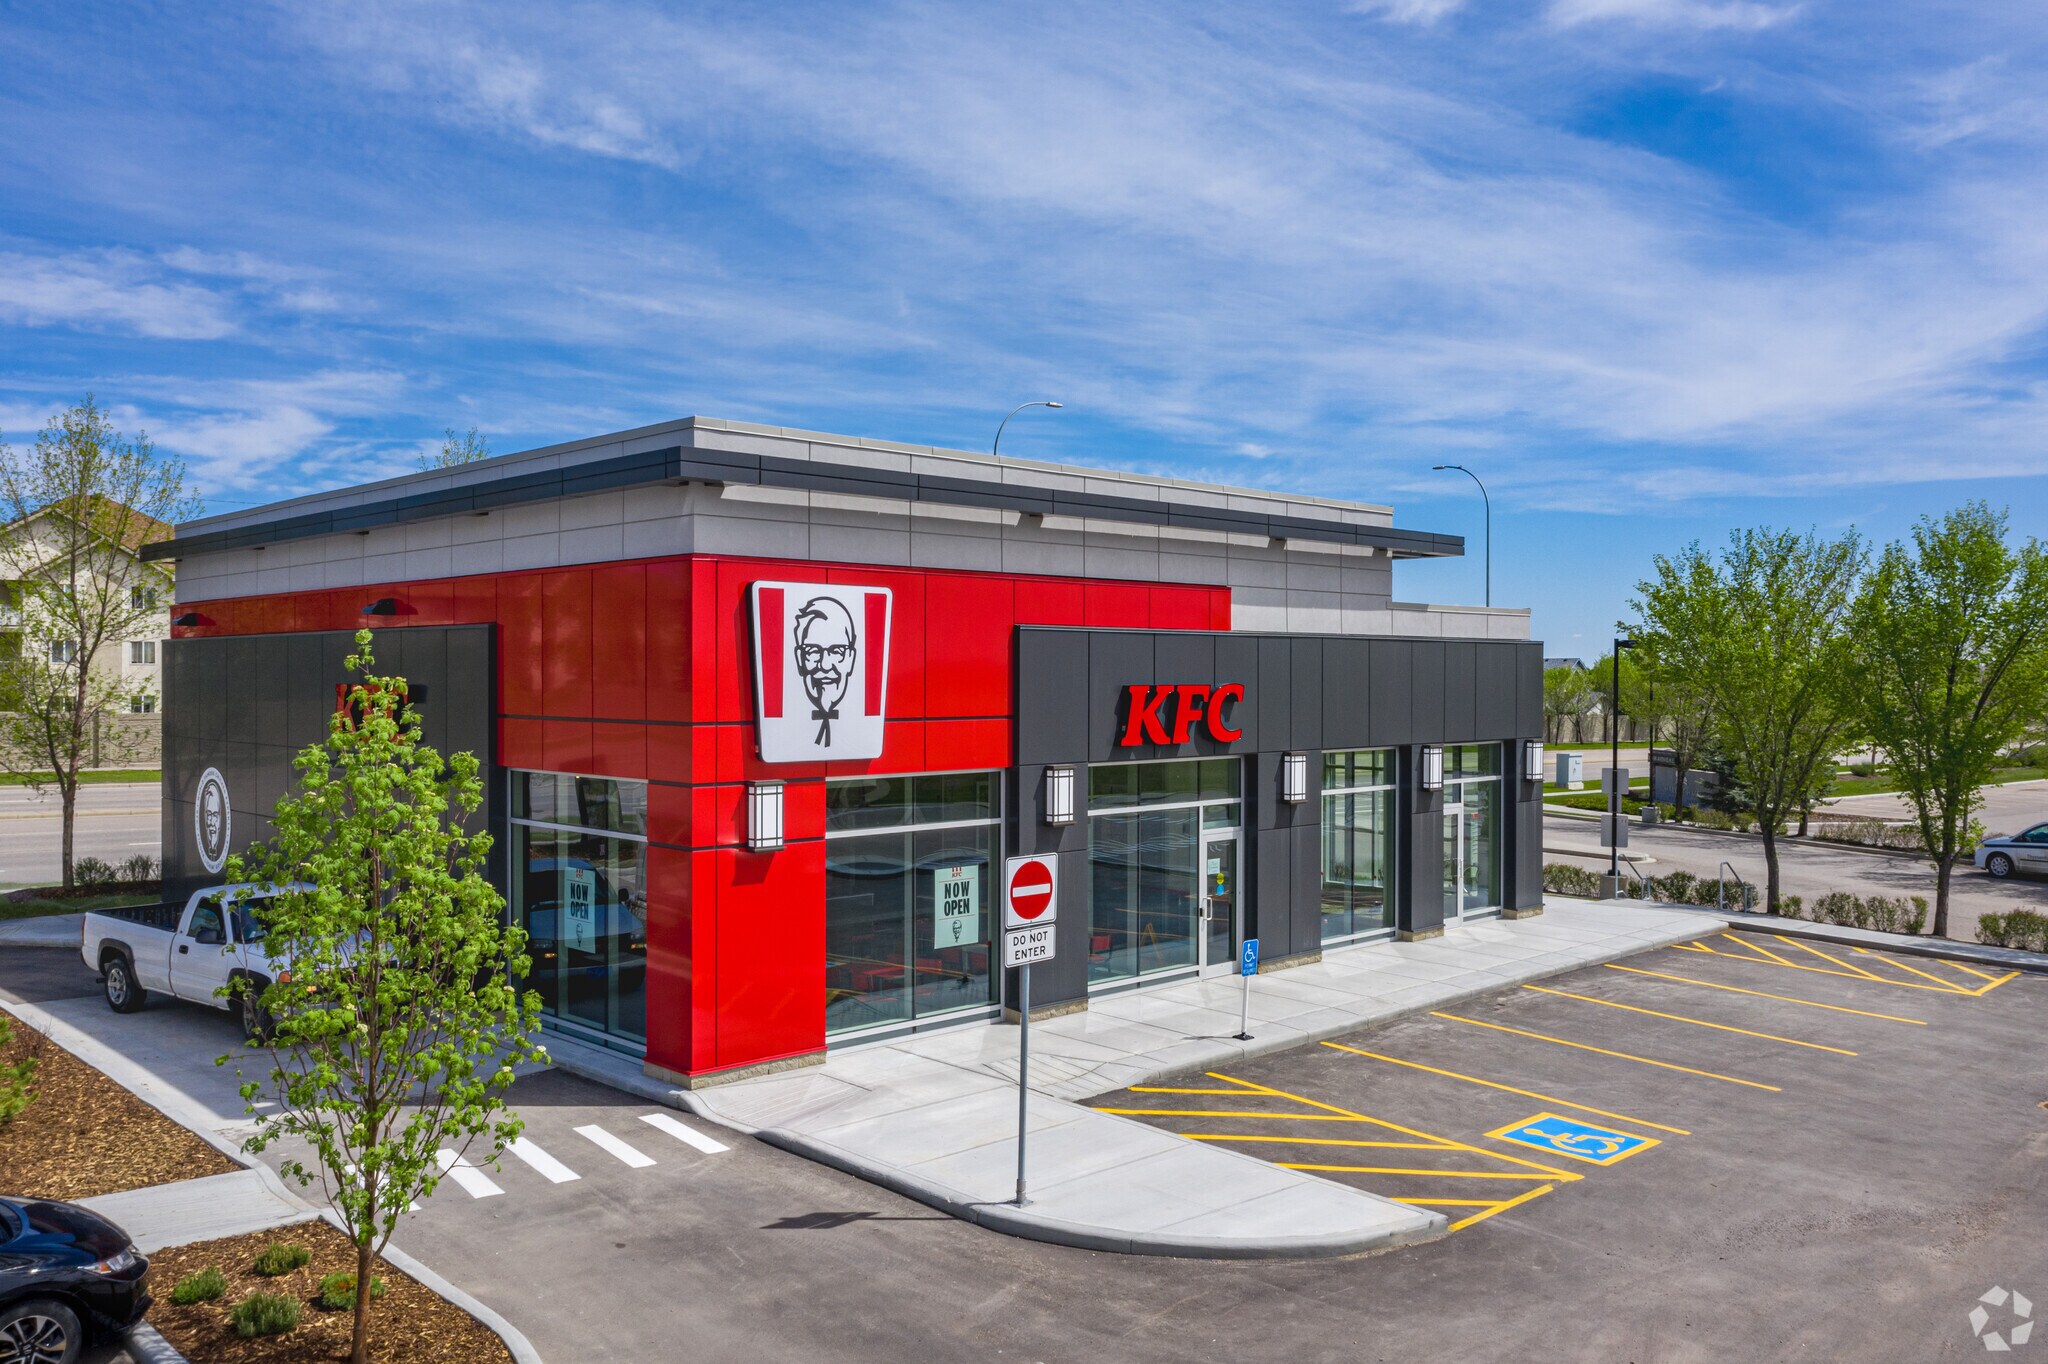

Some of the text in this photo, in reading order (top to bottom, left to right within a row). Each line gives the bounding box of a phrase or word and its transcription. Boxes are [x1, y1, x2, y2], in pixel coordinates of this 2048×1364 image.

[1121, 684, 1245, 746] KFC
[570, 882, 589, 902] NOW
[944, 880, 970, 900] NOW
[570, 901, 589, 920] OPEN
[944, 897, 970, 917] OPEN
[1013, 931, 1048, 947] DO NOT
[1015, 945, 1046, 961] ENTER
